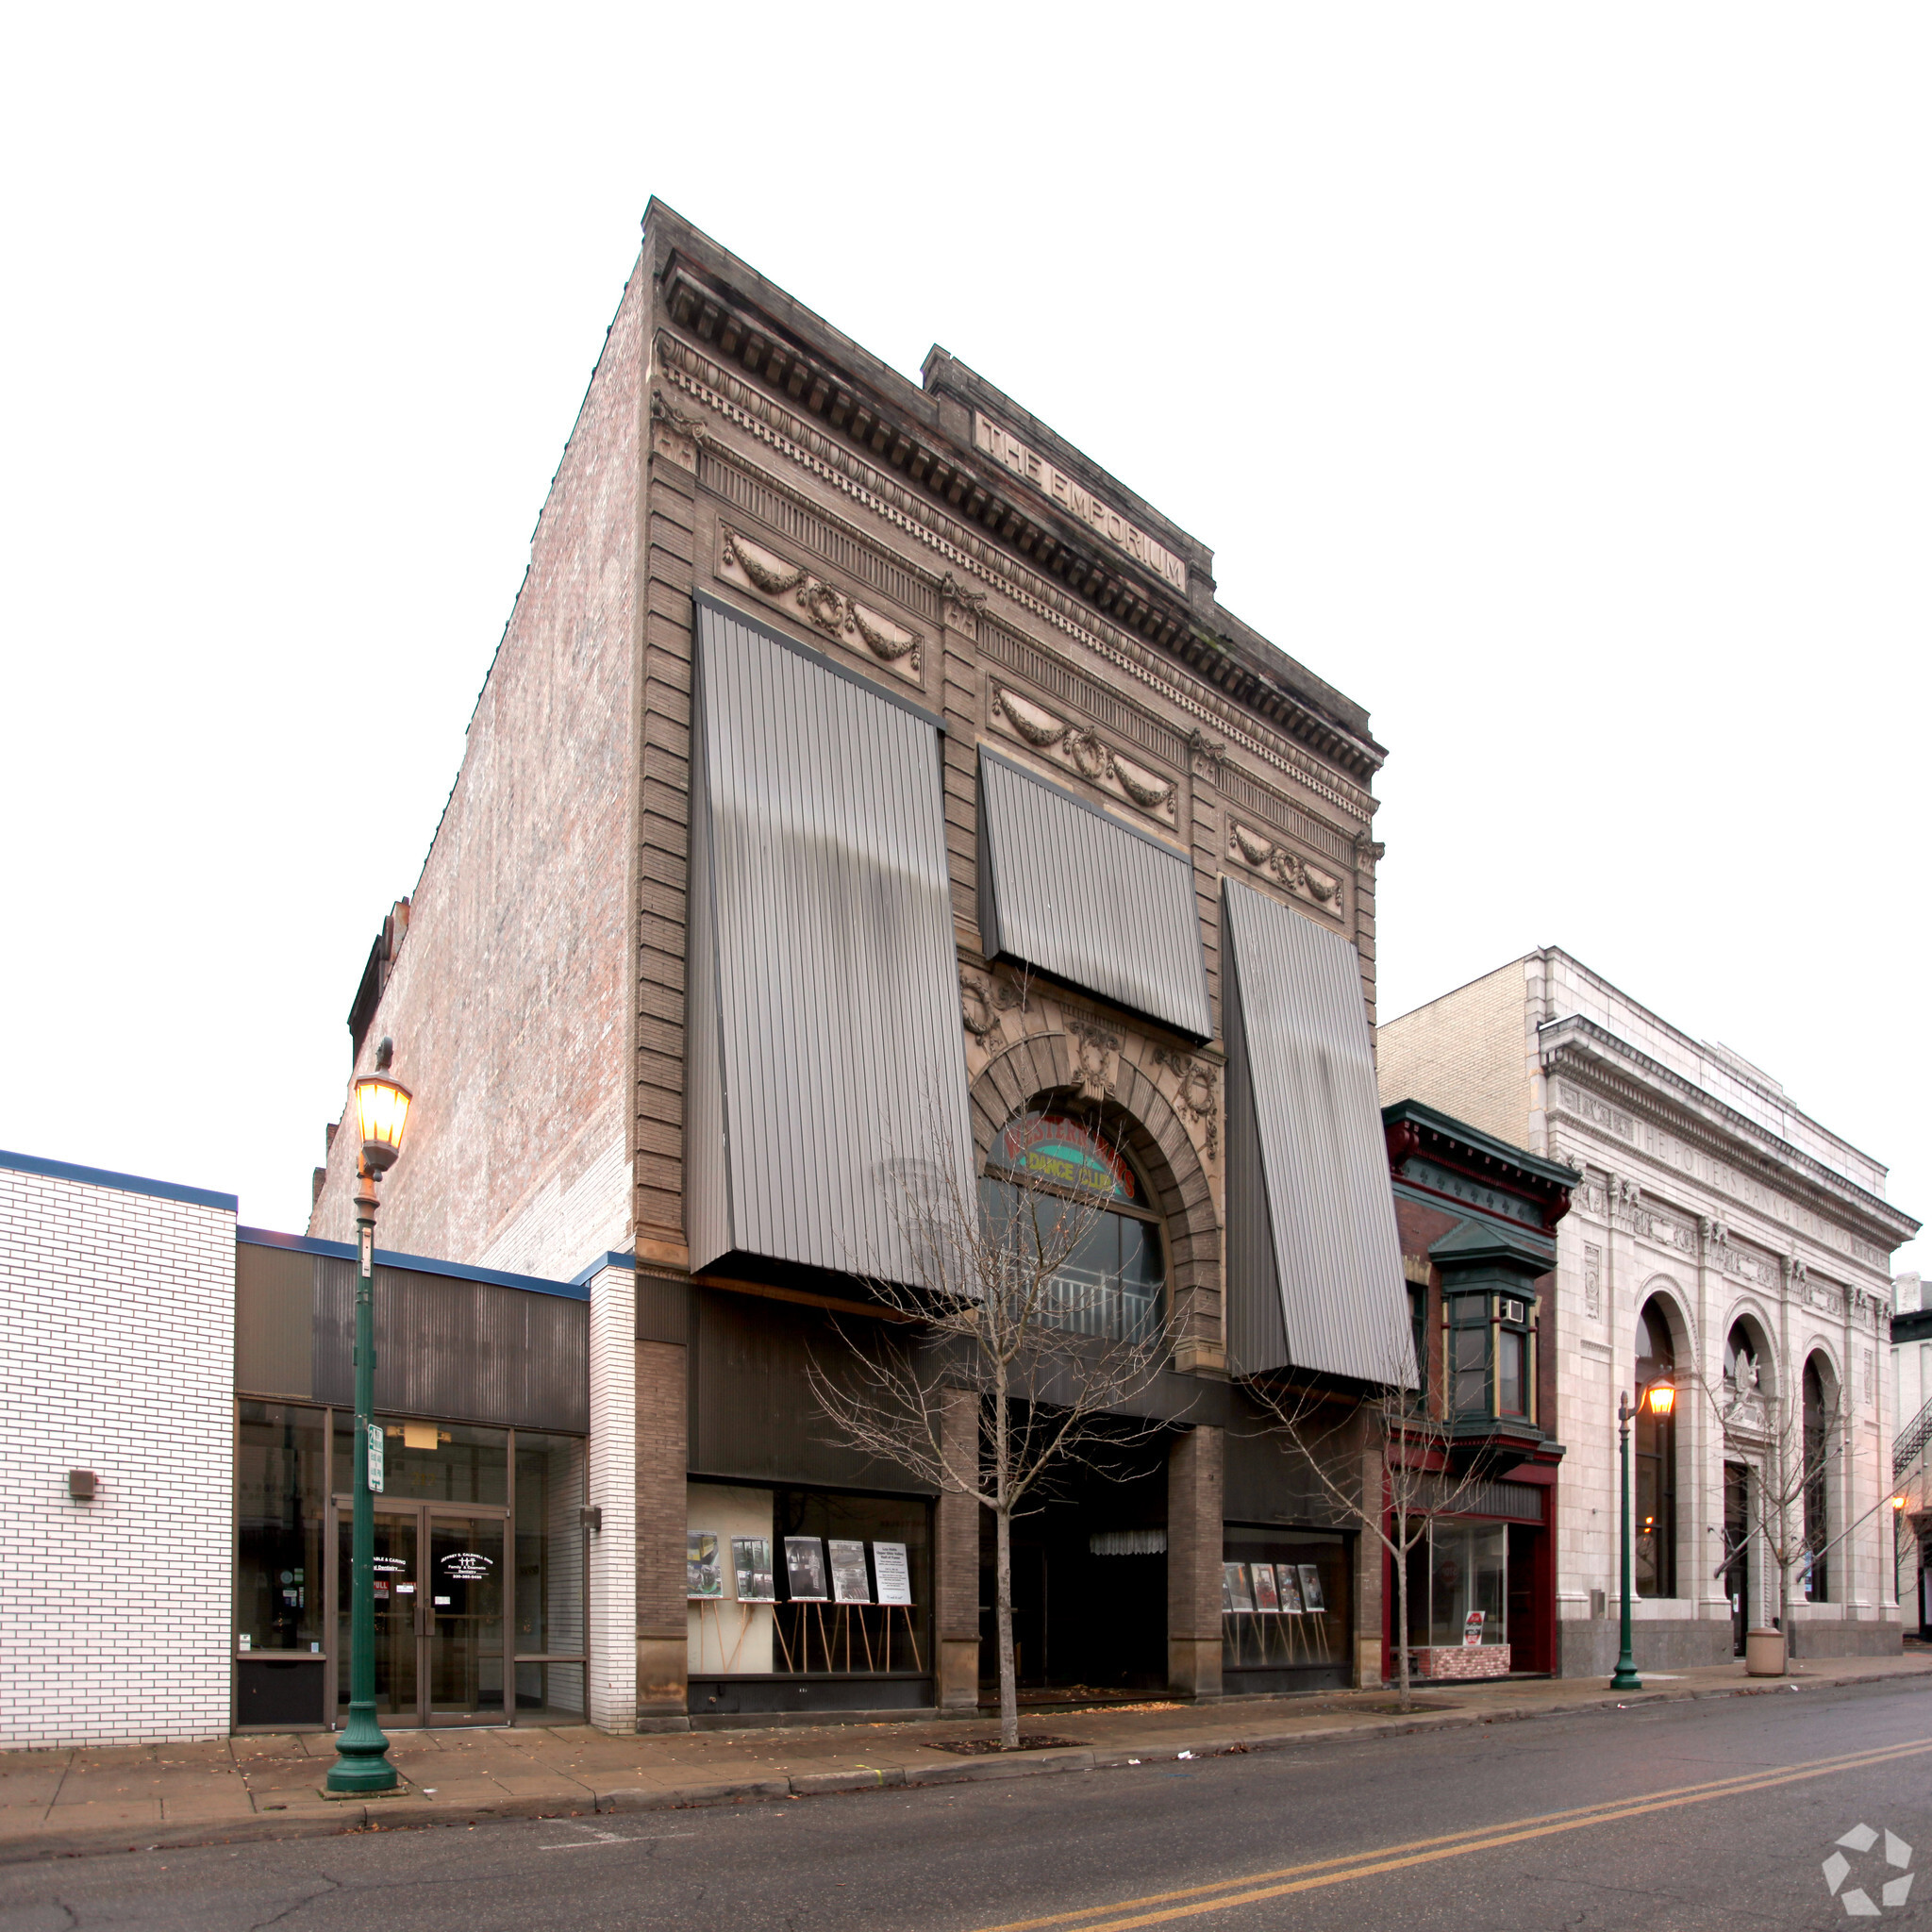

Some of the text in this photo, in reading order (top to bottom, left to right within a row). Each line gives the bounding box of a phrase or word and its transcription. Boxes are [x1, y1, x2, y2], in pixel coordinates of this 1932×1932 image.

[982, 418, 1182, 587] THE EMPORIUM
[1004, 1115, 1091, 1161] WESTERN
[1028, 1151, 1112, 1191] DANCE CLUB
[1634, 1120, 1666, 1159] THE
[1674, 1141, 1737, 1194] POTTERS
[1743, 1178, 1779, 1218] BANK
